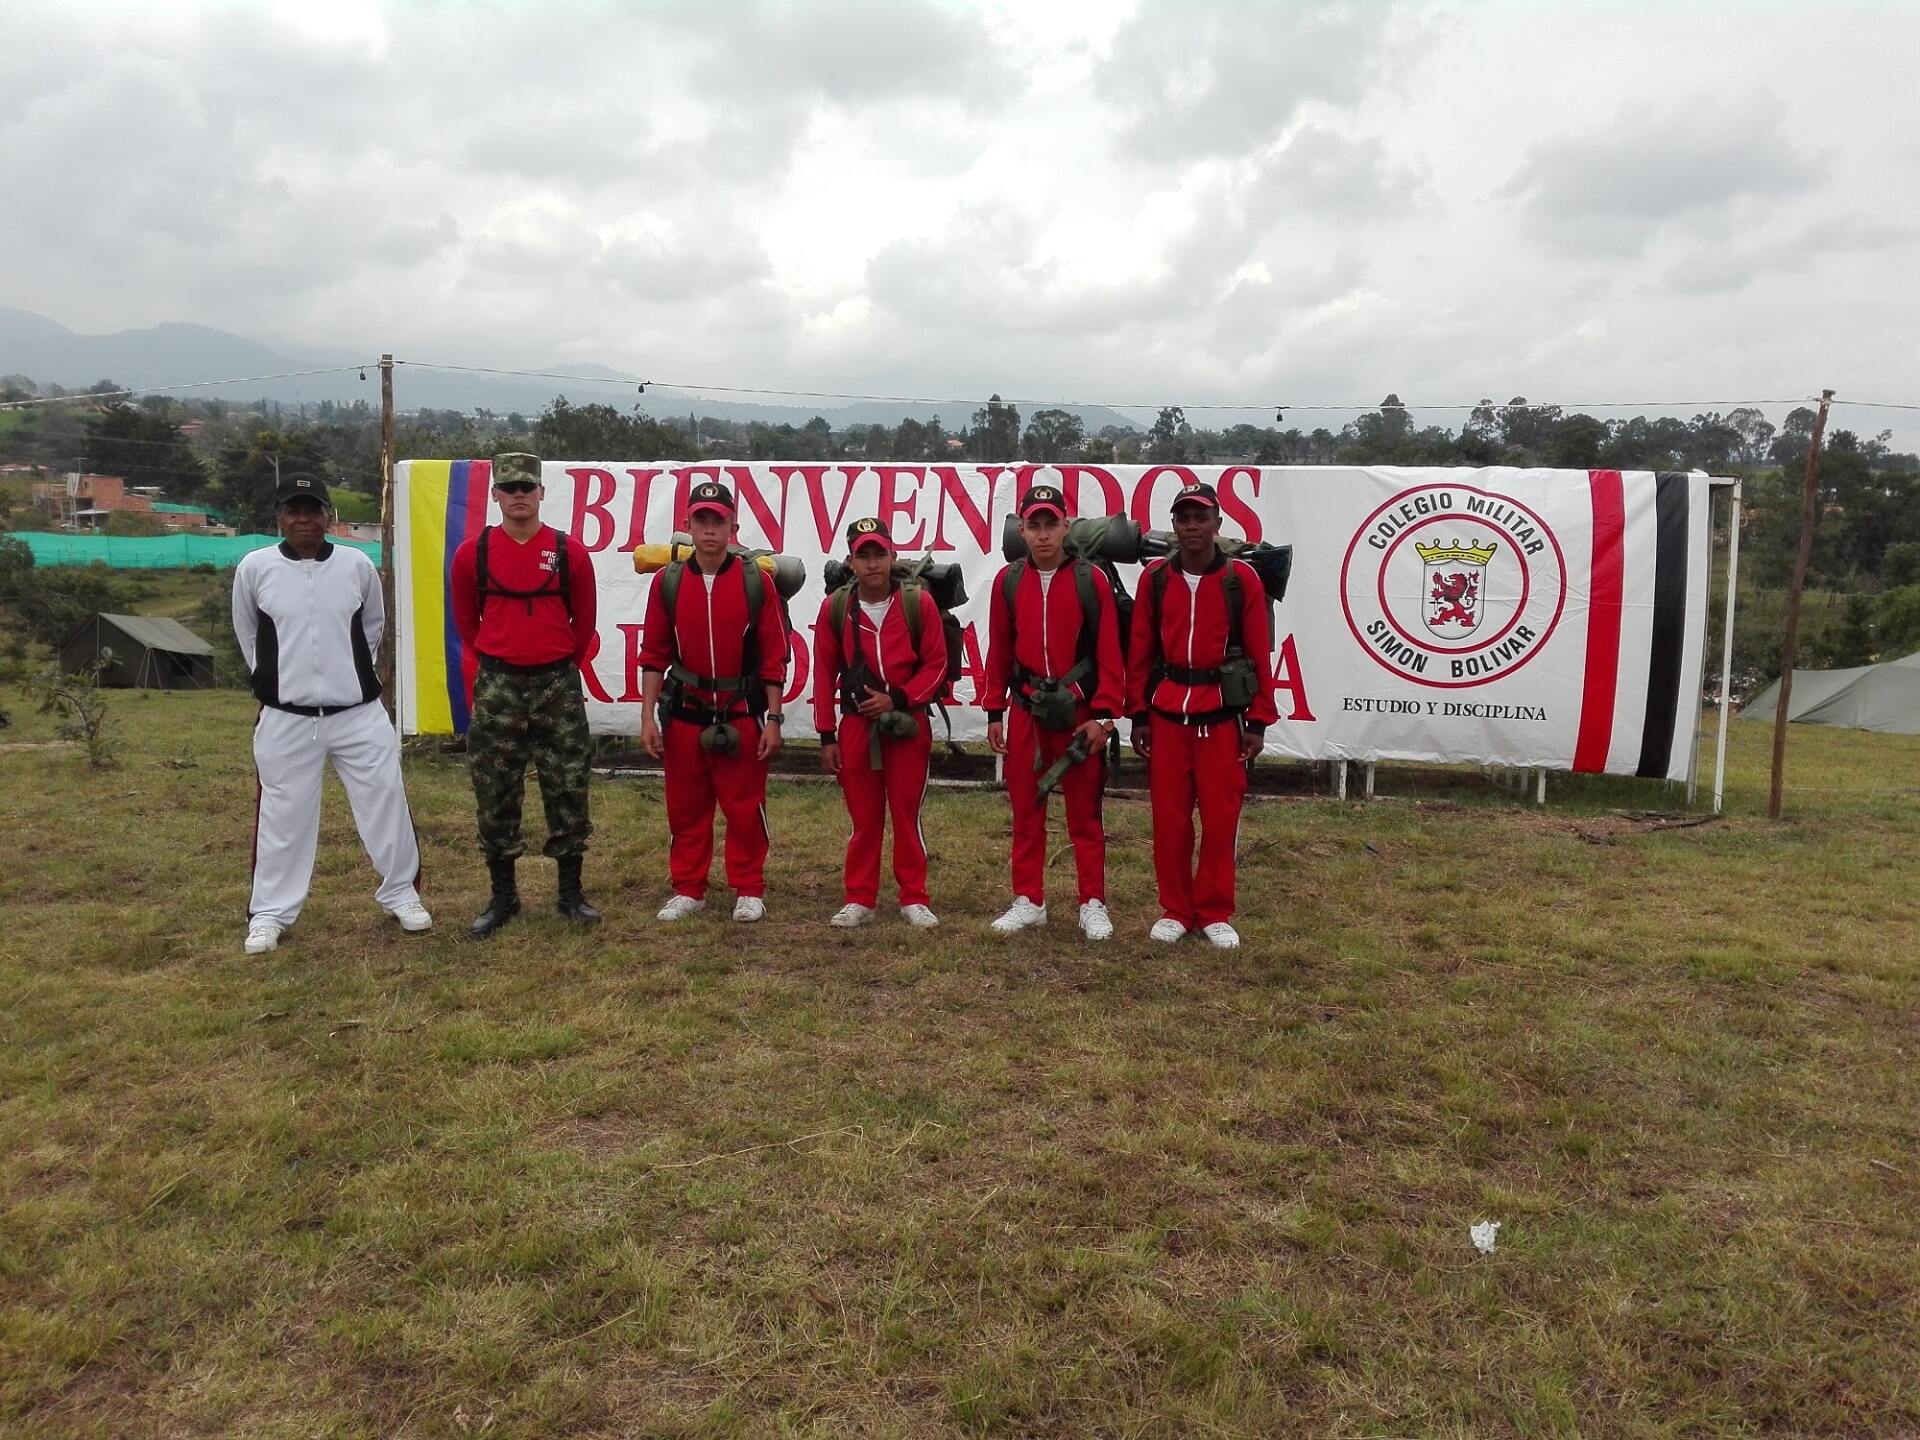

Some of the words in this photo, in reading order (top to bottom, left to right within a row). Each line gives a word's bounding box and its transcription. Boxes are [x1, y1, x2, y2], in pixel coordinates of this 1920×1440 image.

[1368, 492, 1453, 550] COLEGIO
[1467, 495, 1544, 555] MILITAR
[1366, 620, 1429, 672] SIMON
[1451, 625, 1536, 678] BOLIVAR
[1342, 697, 1421, 714] ESTUDIO
[1426, 702, 1438, 714] Y
[1443, 703, 1547, 720] DISCIPLINA
